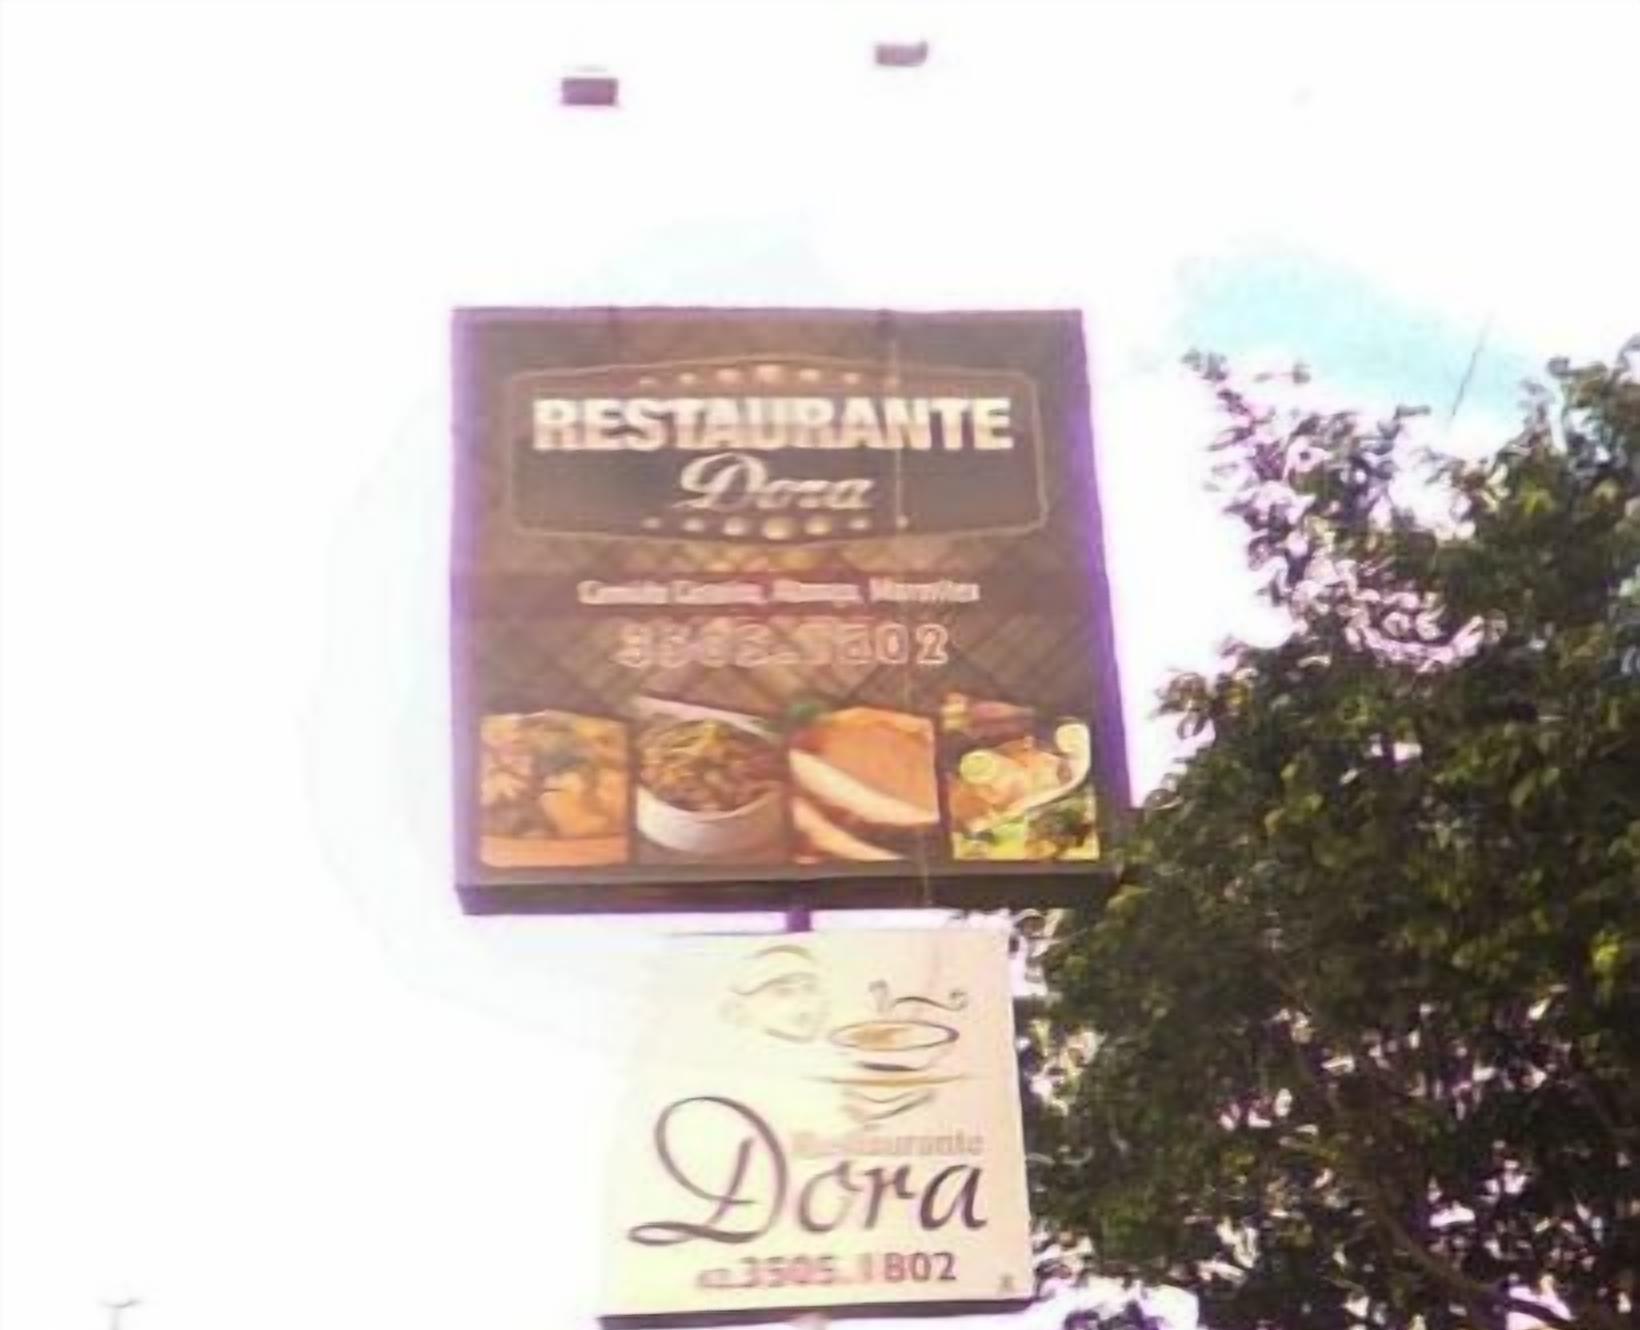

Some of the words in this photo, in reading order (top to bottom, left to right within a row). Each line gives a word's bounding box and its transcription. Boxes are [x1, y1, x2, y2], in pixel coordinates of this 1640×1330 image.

[533, 397, 1014, 451] RESTAURANTE
[671, 452, 875, 509] Dora
[628, 1095, 988, 1246] Dora
